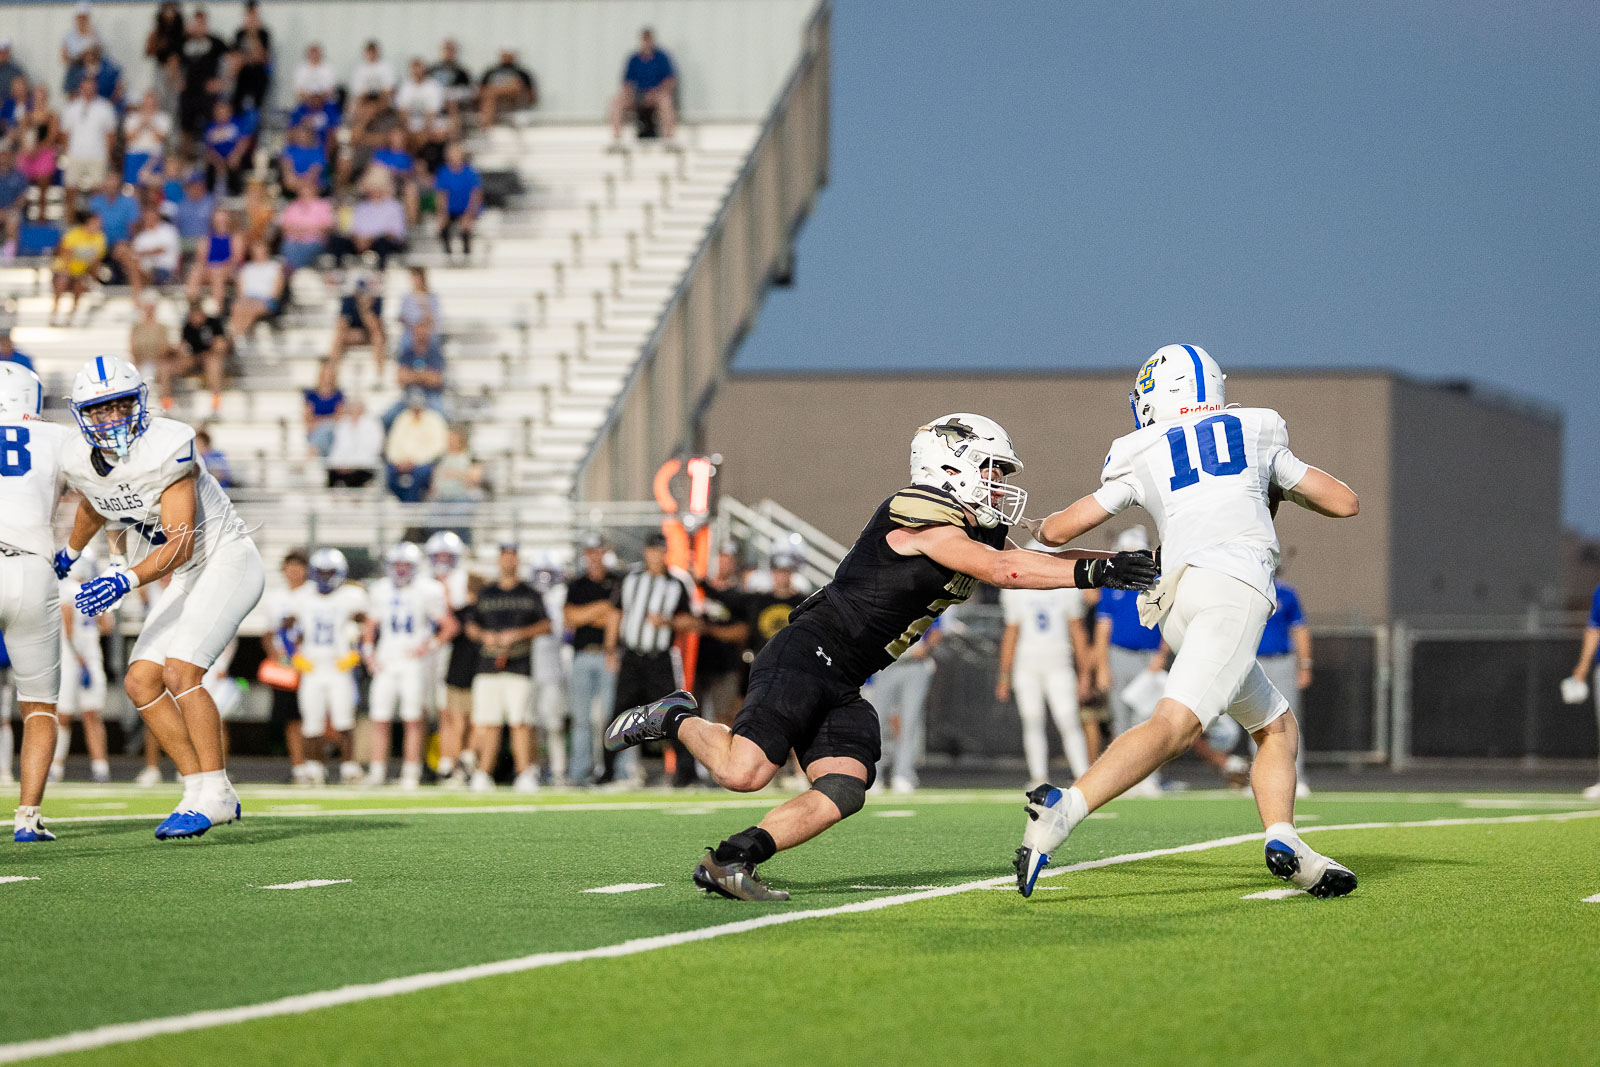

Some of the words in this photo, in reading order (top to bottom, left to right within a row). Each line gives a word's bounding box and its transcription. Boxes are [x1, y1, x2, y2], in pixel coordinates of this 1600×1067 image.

[0, 426, 32, 477] 8
[1165, 414, 1248, 491] 10
[94, 493, 144, 512] EAGLES
